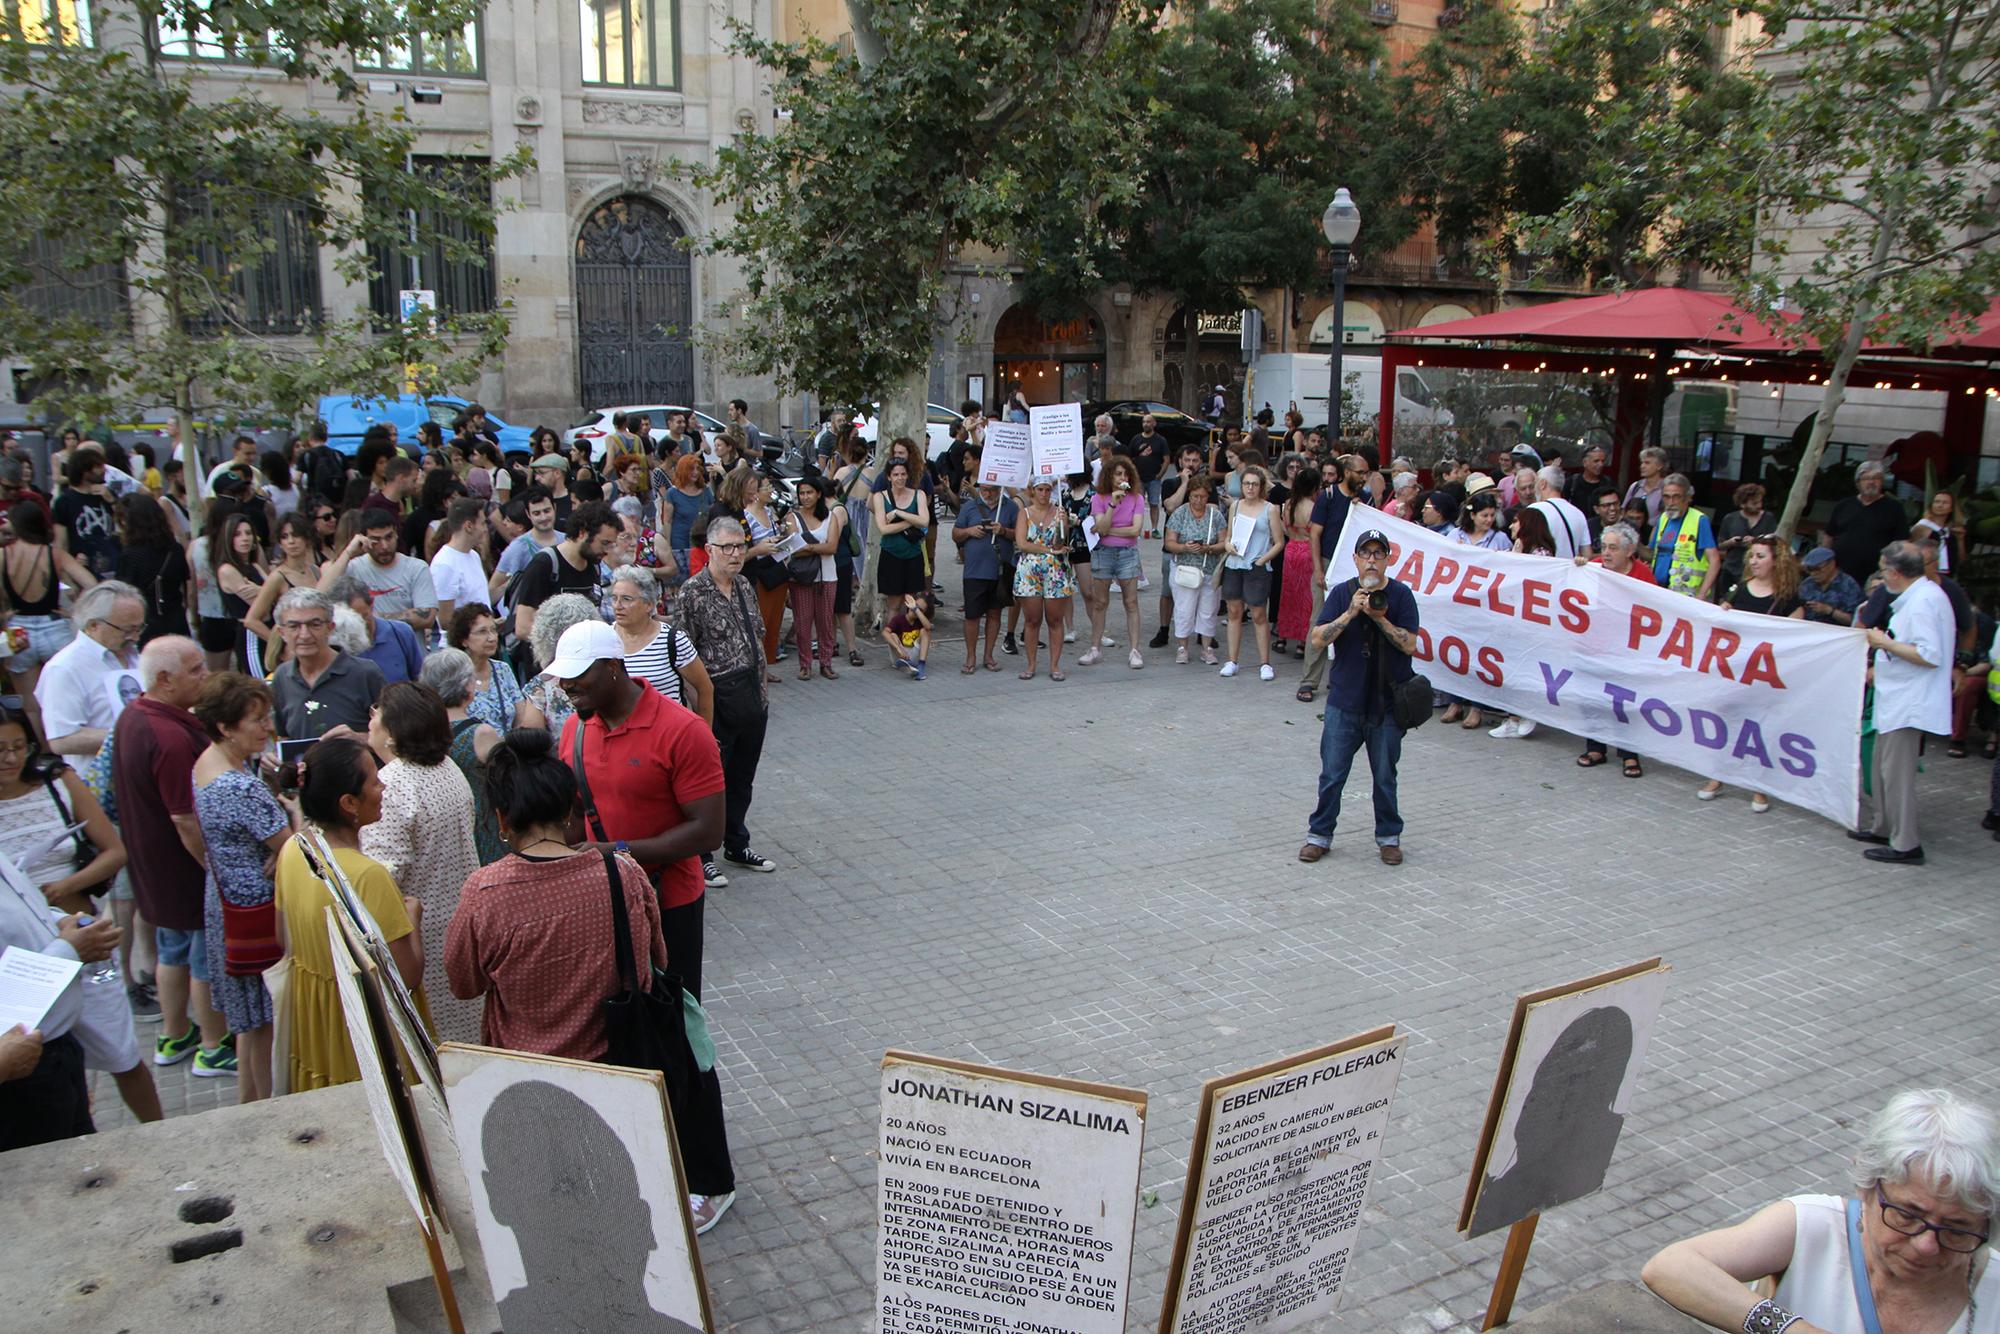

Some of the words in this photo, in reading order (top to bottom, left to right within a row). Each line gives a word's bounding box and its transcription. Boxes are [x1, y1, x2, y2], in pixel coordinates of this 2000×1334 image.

[1626, 603, 1788, 690] PARA
[1538, 661, 1574, 707] Y
[1603, 682, 1818, 779] TODAS
[1221, 1074, 1308, 1114] EBENIZER
[1311, 1045, 1399, 1085] FOLEFACK
[886, 1117, 902, 1129] 20
[905, 1119, 947, 1136] AÑOS
[887, 1078, 1013, 1114] JONATHAN
[1019, 1100, 1130, 1135] SIZALIMA
[1212, 1133, 1281, 1165] SOLICITANTE
[1282, 1128, 1297, 1141] DE
[1298, 1117, 1329, 1135] ASILO
[1330, 1111, 1345, 1124] EN
[1345, 1097, 1388, 1119] BÉLGICA
[1215, 1127, 1259, 1150] NACIDO
[1261, 1121, 1278, 1134] EN
[1279, 1102, 1334, 1128] CAMERÚN
[1217, 1123, 1231, 1135] 32
[1232, 1111, 1265, 1130] AÑOS
[885, 1152, 922, 1168] VIVÍA
[925, 1160, 945, 1173] EN
[949, 1164, 1040, 1190] BARCELONA
[886, 1135, 931, 1152] NACIÓ
[935, 1143, 955, 1156] EN
[959, 1147, 1031, 1170] ECUADOR
[1206, 1169, 1267, 1198] DEPORTAR
[1273, 1165, 1281, 1174] A
[1287, 1143, 1340, 1169] EBENIAR
[1345, 1135, 1361, 1148] EN
[1366, 1130, 1379, 1141] EL
[1208, 1175, 1223, 1188] LA
[1226, 1159, 1270, 1181] POLICÍA
[1272, 1145, 1309, 1165] BELGA
[1311, 1128, 1356, 1151] INTENTÓ
[884, 1177, 904, 1189] EN
[907, 1181, 939, 1196] 2009
[943, 1187, 971, 1202] FUE
[975, 1193, 1049, 1215] DETENIDO
[1053, 1207, 1063, 1217] Y
[1198, 1228, 1214, 1241] LO
[1218, 1216, 1248, 1233] CUAL
[1253, 1208, 1267, 1220] LA
[1349, 1169, 1369, 1183] FUE
[1205, 1188, 1243, 1208] VUELO
[1254, 1193, 1284, 1210] PUSO
[1286, 1168, 1349, 1198] RESISTENCIA
[1350, 1159, 1372, 1174] POR
[884, 1189, 983, 1216] TRASLADADO
[985, 1208, 1005, 1220] AL
[1008, 1212, 1069, 1231] CENTRO
[1073, 1223, 1093, 1236] DE
[884, 1201, 990, 1229] INTERNAMIENTO
[992, 1221, 1011, 1234] DE
[1014, 1225, 1113, 1252] EXTRANJEROS
[884, 1213, 903, 1226] DE
[906, 1217, 946, 1233] ZONA
[950, 1225, 1012, 1247] FRANCA,
[1017, 1238, 1069, 1256] HORAS
[1072, 1248, 1105, 1263] MAS
[1192, 1259, 1208, 1271] EN
[1210, 1254, 1223, 1265] EL
[1226, 1236, 1268, 1258] CENTRO
[1270, 1229, 1285, 1241] DE
[1287, 1199, 1362, 1235] INTERNAMIENTO
[1194, 1252, 1202, 1261] A
[1208, 1241, 1231, 1256] UNA
[1236, 1225, 1273, 1245] CELDA
[1277, 1217, 1293, 1229] DE
[1296, 1189, 1364, 1222] AISLAMIENTO
[1196, 1219, 1264, 1251] SUSPENDIDA
[1268, 1214, 1275, 1223] Y
[1276, 1206, 1297, 1220] FUE
[1300, 1179, 1367, 1211] TRASLADADO
[883, 1225, 934, 1244] TARDE,
[937, 1235, 1004, 1256] SIZALIMA
[1006, 1248, 1080, 1270] APARECÍA
[883, 1237, 965, 1260] AHORCADO
[969, 1252, 988, 1265] EN
[992, 1257, 1011, 1269] SU
[1015, 1261, 1068, 1281] CELDA,
[1072, 1272, 1092, 1285] EN
[1096, 1276, 1117, 1289] UN
[1186, 1270, 1250, 1302] POLICIALES
[1252, 1263, 1267, 1275] SE
[1268, 1245, 1311, 1269] SUICIDÓ
[1188, 1279, 1204, 1292] EN
[1215, 1259, 1254, 1281] DONDE
[1311, 1218, 1357, 1243] FUENTES
[1190, 1269, 1205, 1282] DE
[1210, 1240, 1281, 1274] EXTRANJEROS
[1285, 1232, 1299, 1244] DE
[883, 1248, 959, 1271] SUPUESTO
[962, 1263, 1025, 1283] SUICIDIO
[1028, 1276, 1066, 1292] PESE
[1069, 1284, 1080, 1294] A
[1083, 1286, 1114, 1301] QUE
[883, 1260, 900, 1272] YA
[903, 1264, 921, 1276] SE
[924, 1268, 967, 1284] HABÍA
[1041, 1290, 1061, 1302] SU
[1064, 1294, 1115, 1313] ORDEN
[883, 1271, 902, 1283] DE
[905, 1275, 1026, 1307] EXCARCELACIÓN
[1182, 1309, 1197, 1322] LA
[1208, 1283, 1262, 1311] AUTOPSIA
[1275, 1270, 1295, 1284] DEL
[1308, 1247, 1349, 1270] CUERPO
[1226, 1295, 1275, 1321] DIVERSOS
[1316, 1271, 1331, 1283] NO
[1331, 1265, 1344, 1277] SE
[882, 1294, 892, 1304] A
[895, 1296, 922, 1310] LOS
[925, 1302, 980, 1321] PADRES
[983, 1313, 1010, 1328] DEL
[882, 1305, 900, 1317] SE
[904, 1309, 931, 1323] LES
[882, 1316, 900, 1328] EL
[1180, 1306, 1224, 1331] REVELÓ
[1228, 1295, 1251, 1311] QUE
[1255, 1273, 1306, 1301] EBENIZAR
[1210, 1324, 1225, 1334] UN
[1226, 1304, 1274, 1330] PROCESO
[1275, 1287, 1315, 1309] JUDICIAL
[1317, 1275, 1341, 1291] PARA
[1255, 1315, 1268, 1326] LA
[1277, 1293, 1318, 1317] MUERTE
[1325, 1283, 1339, 1296] DE
